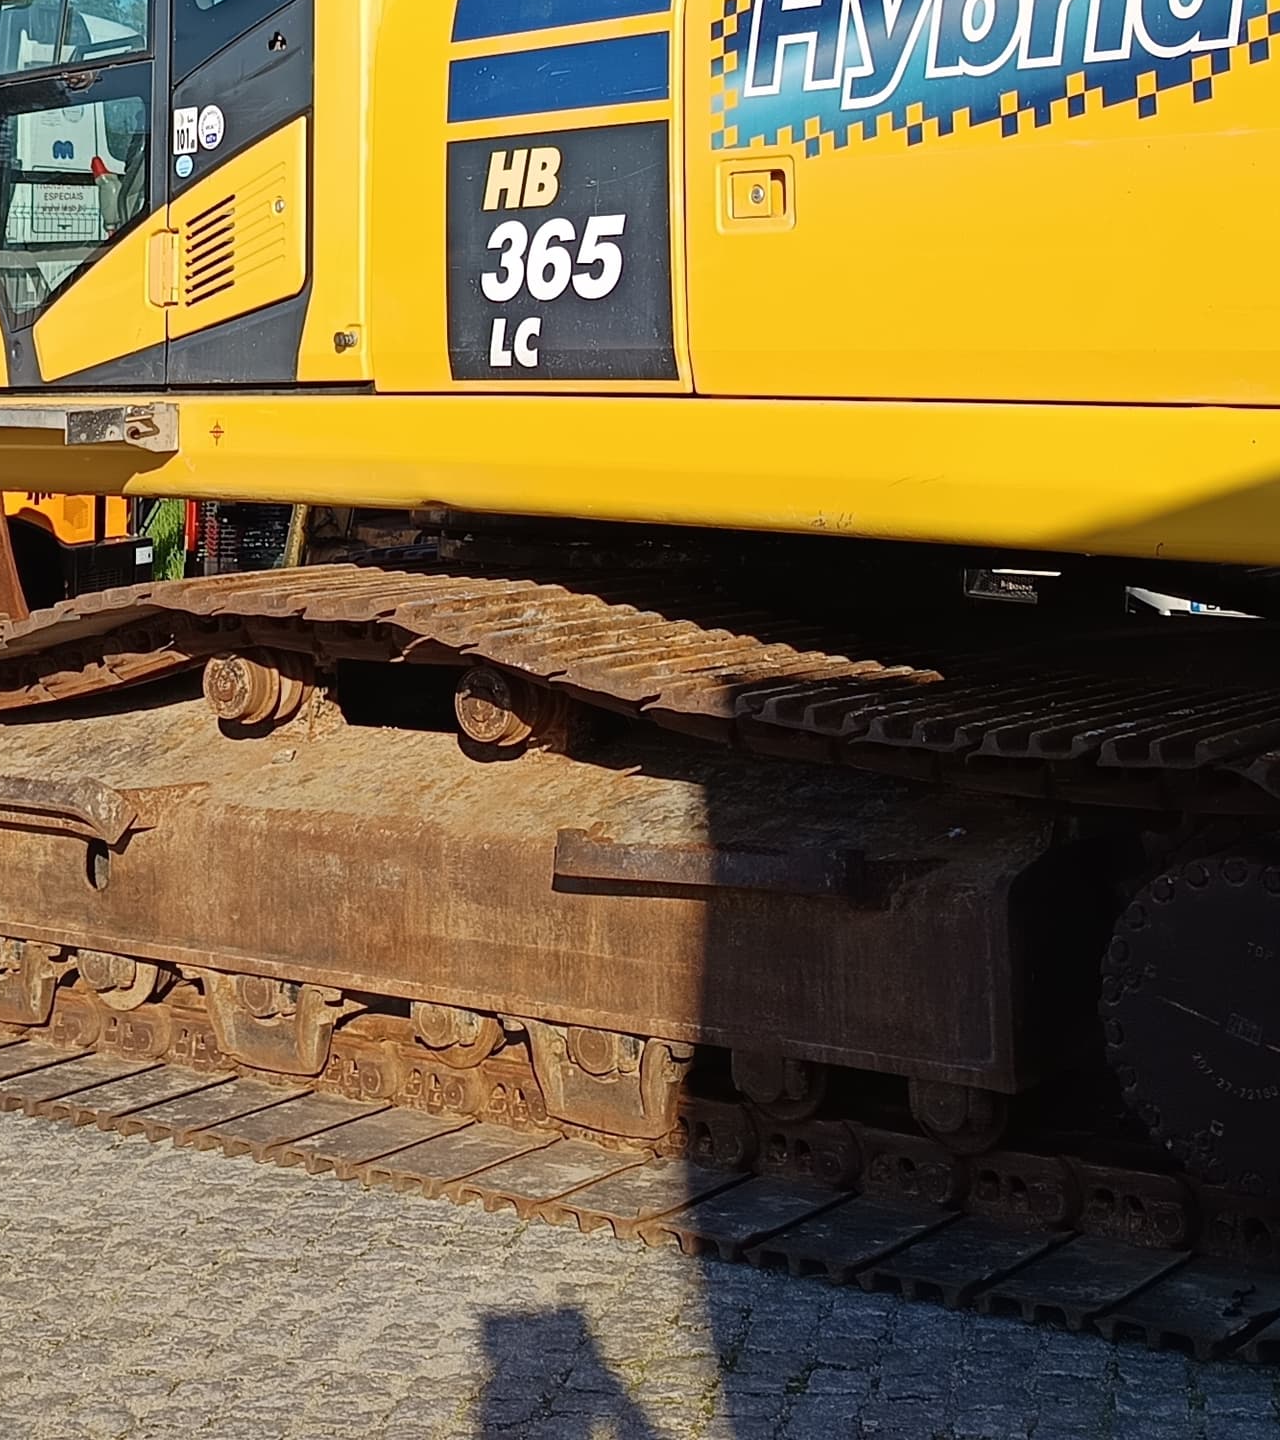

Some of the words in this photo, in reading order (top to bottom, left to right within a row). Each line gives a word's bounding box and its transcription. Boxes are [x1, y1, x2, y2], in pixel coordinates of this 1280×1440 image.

[176, 127, 190, 151] 101
[43, 192, 84, 201] ESPECIAIS
[482, 147, 561, 211] HB
[480, 213, 627, 302] 365
[488, 317, 542, 368] LC
